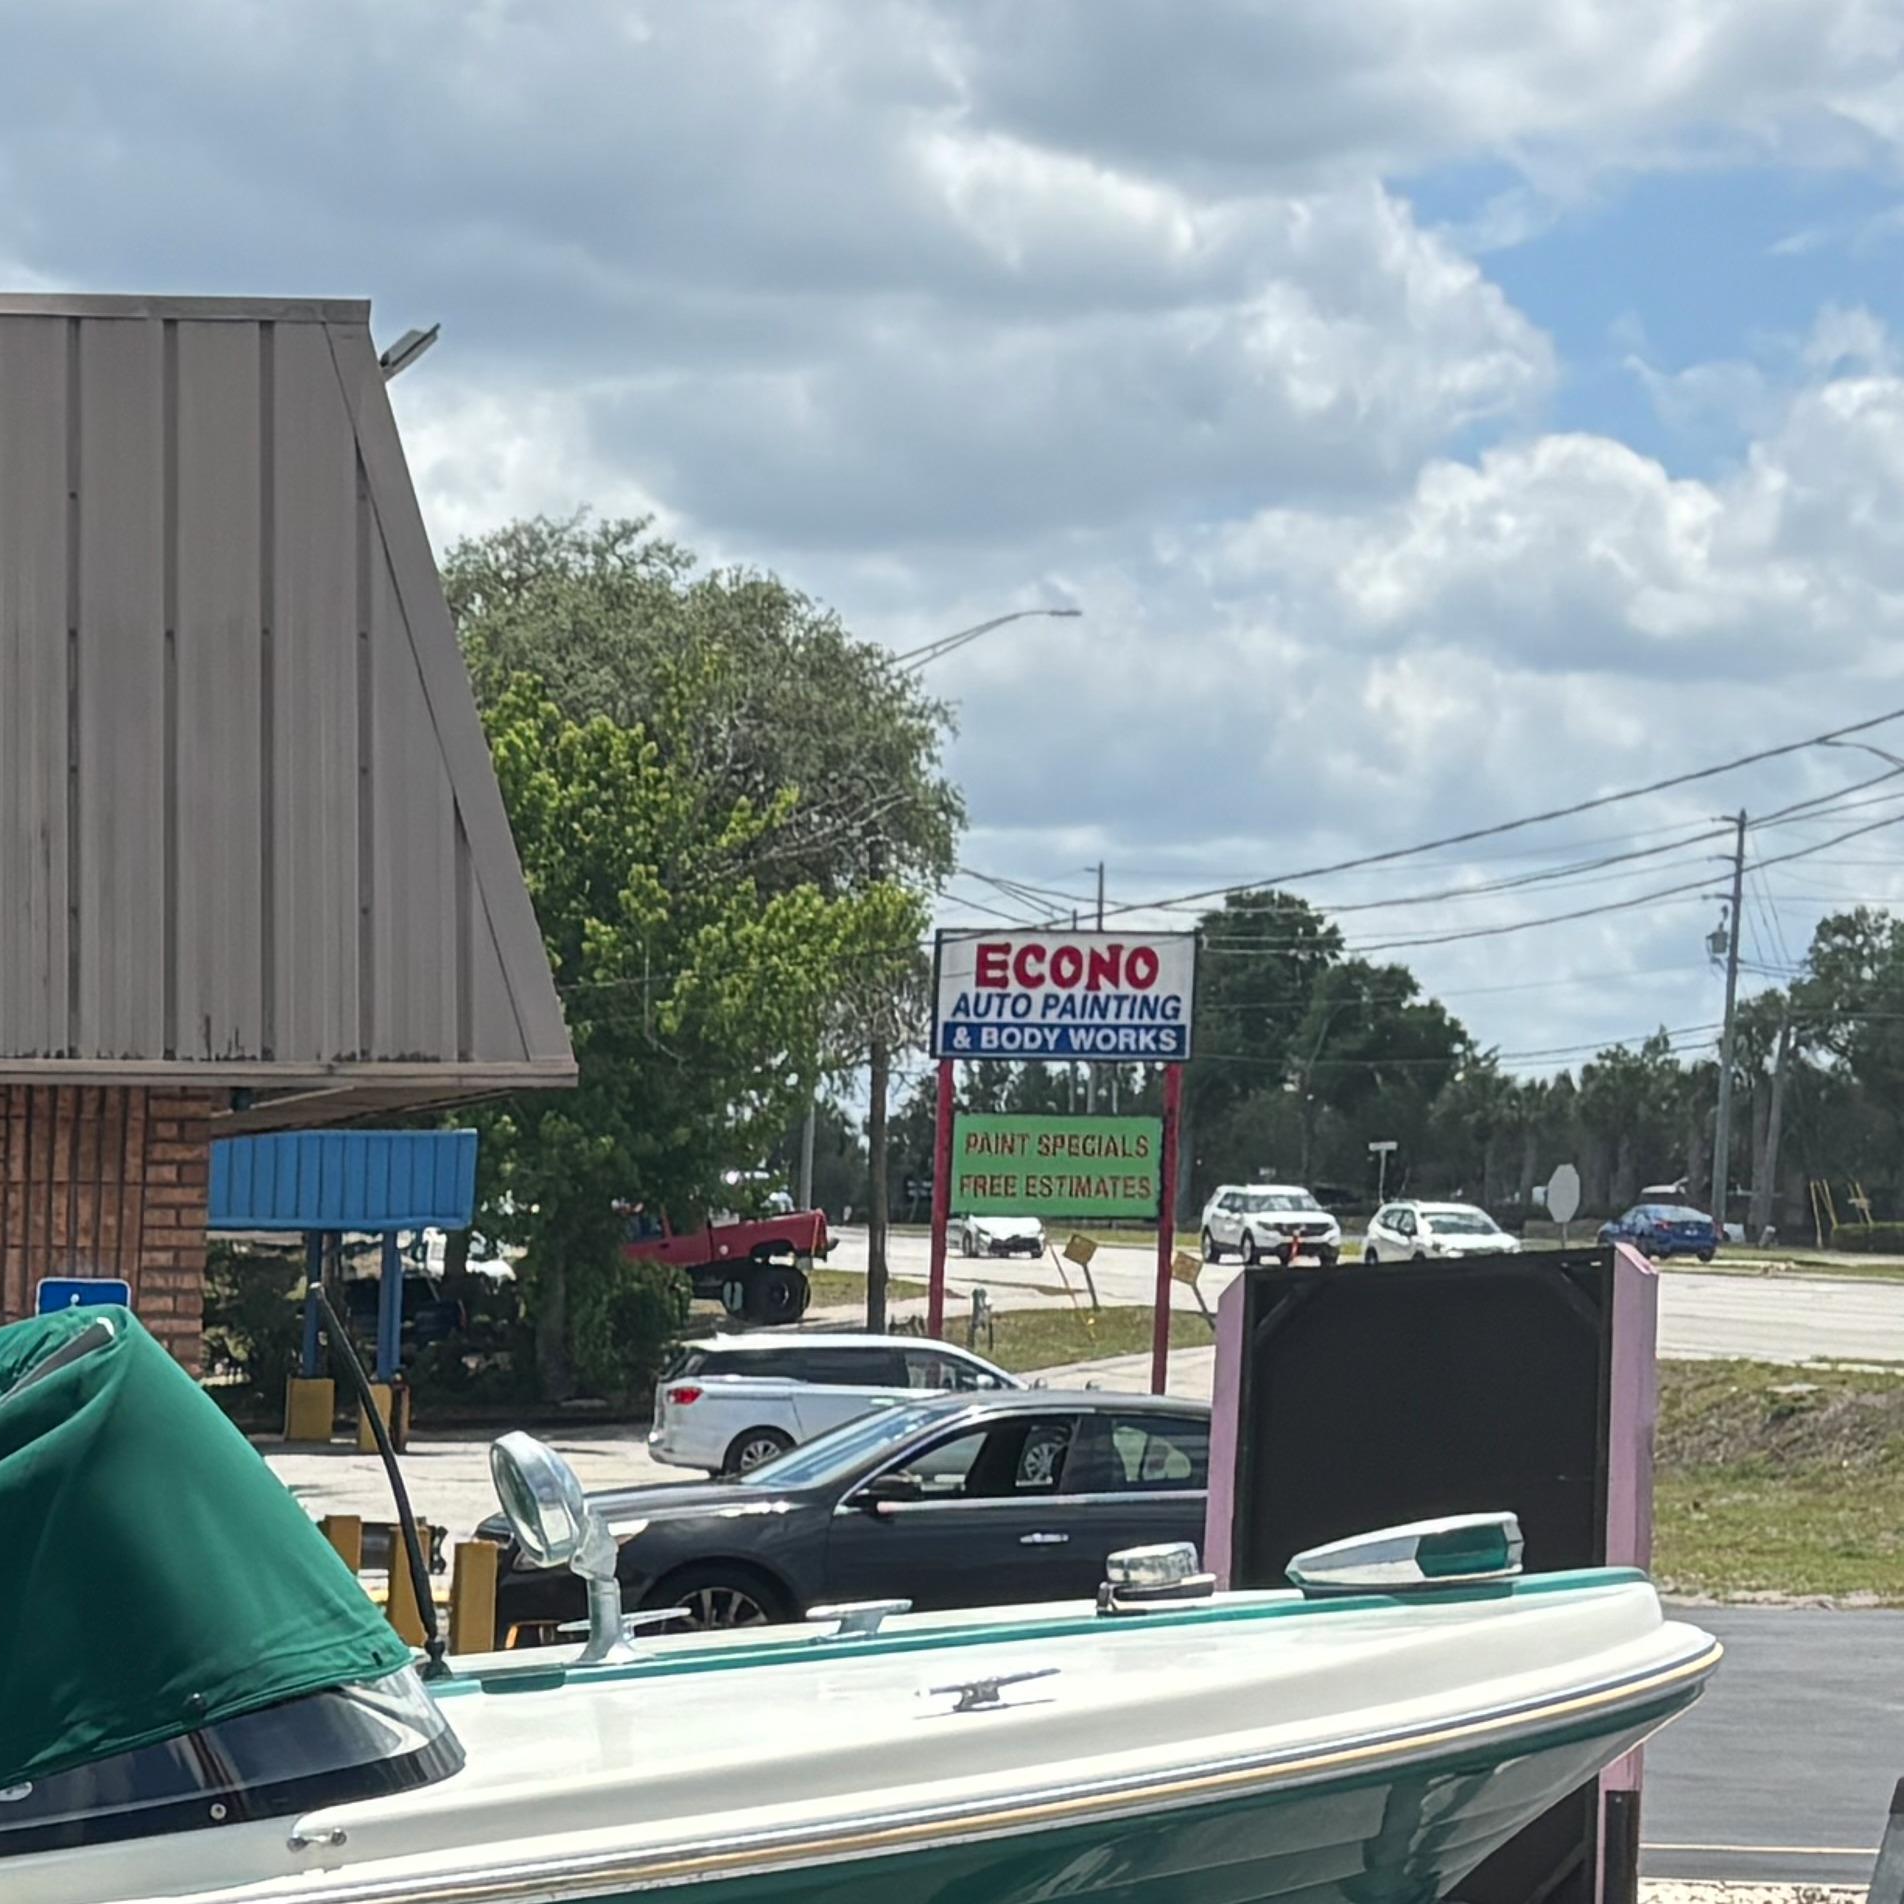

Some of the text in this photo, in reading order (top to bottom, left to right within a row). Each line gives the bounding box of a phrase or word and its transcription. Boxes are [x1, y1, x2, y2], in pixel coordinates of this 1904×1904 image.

[975, 943, 1159, 991] ECONO
[951, 993, 1181, 1020] AUTO PAINTING
[952, 1027, 1177, 1051] & BODY WORKS
[965, 1132, 1149, 1158] PAINT SPECIALS
[959, 1175, 1152, 1199] FREE ESTIMATES
